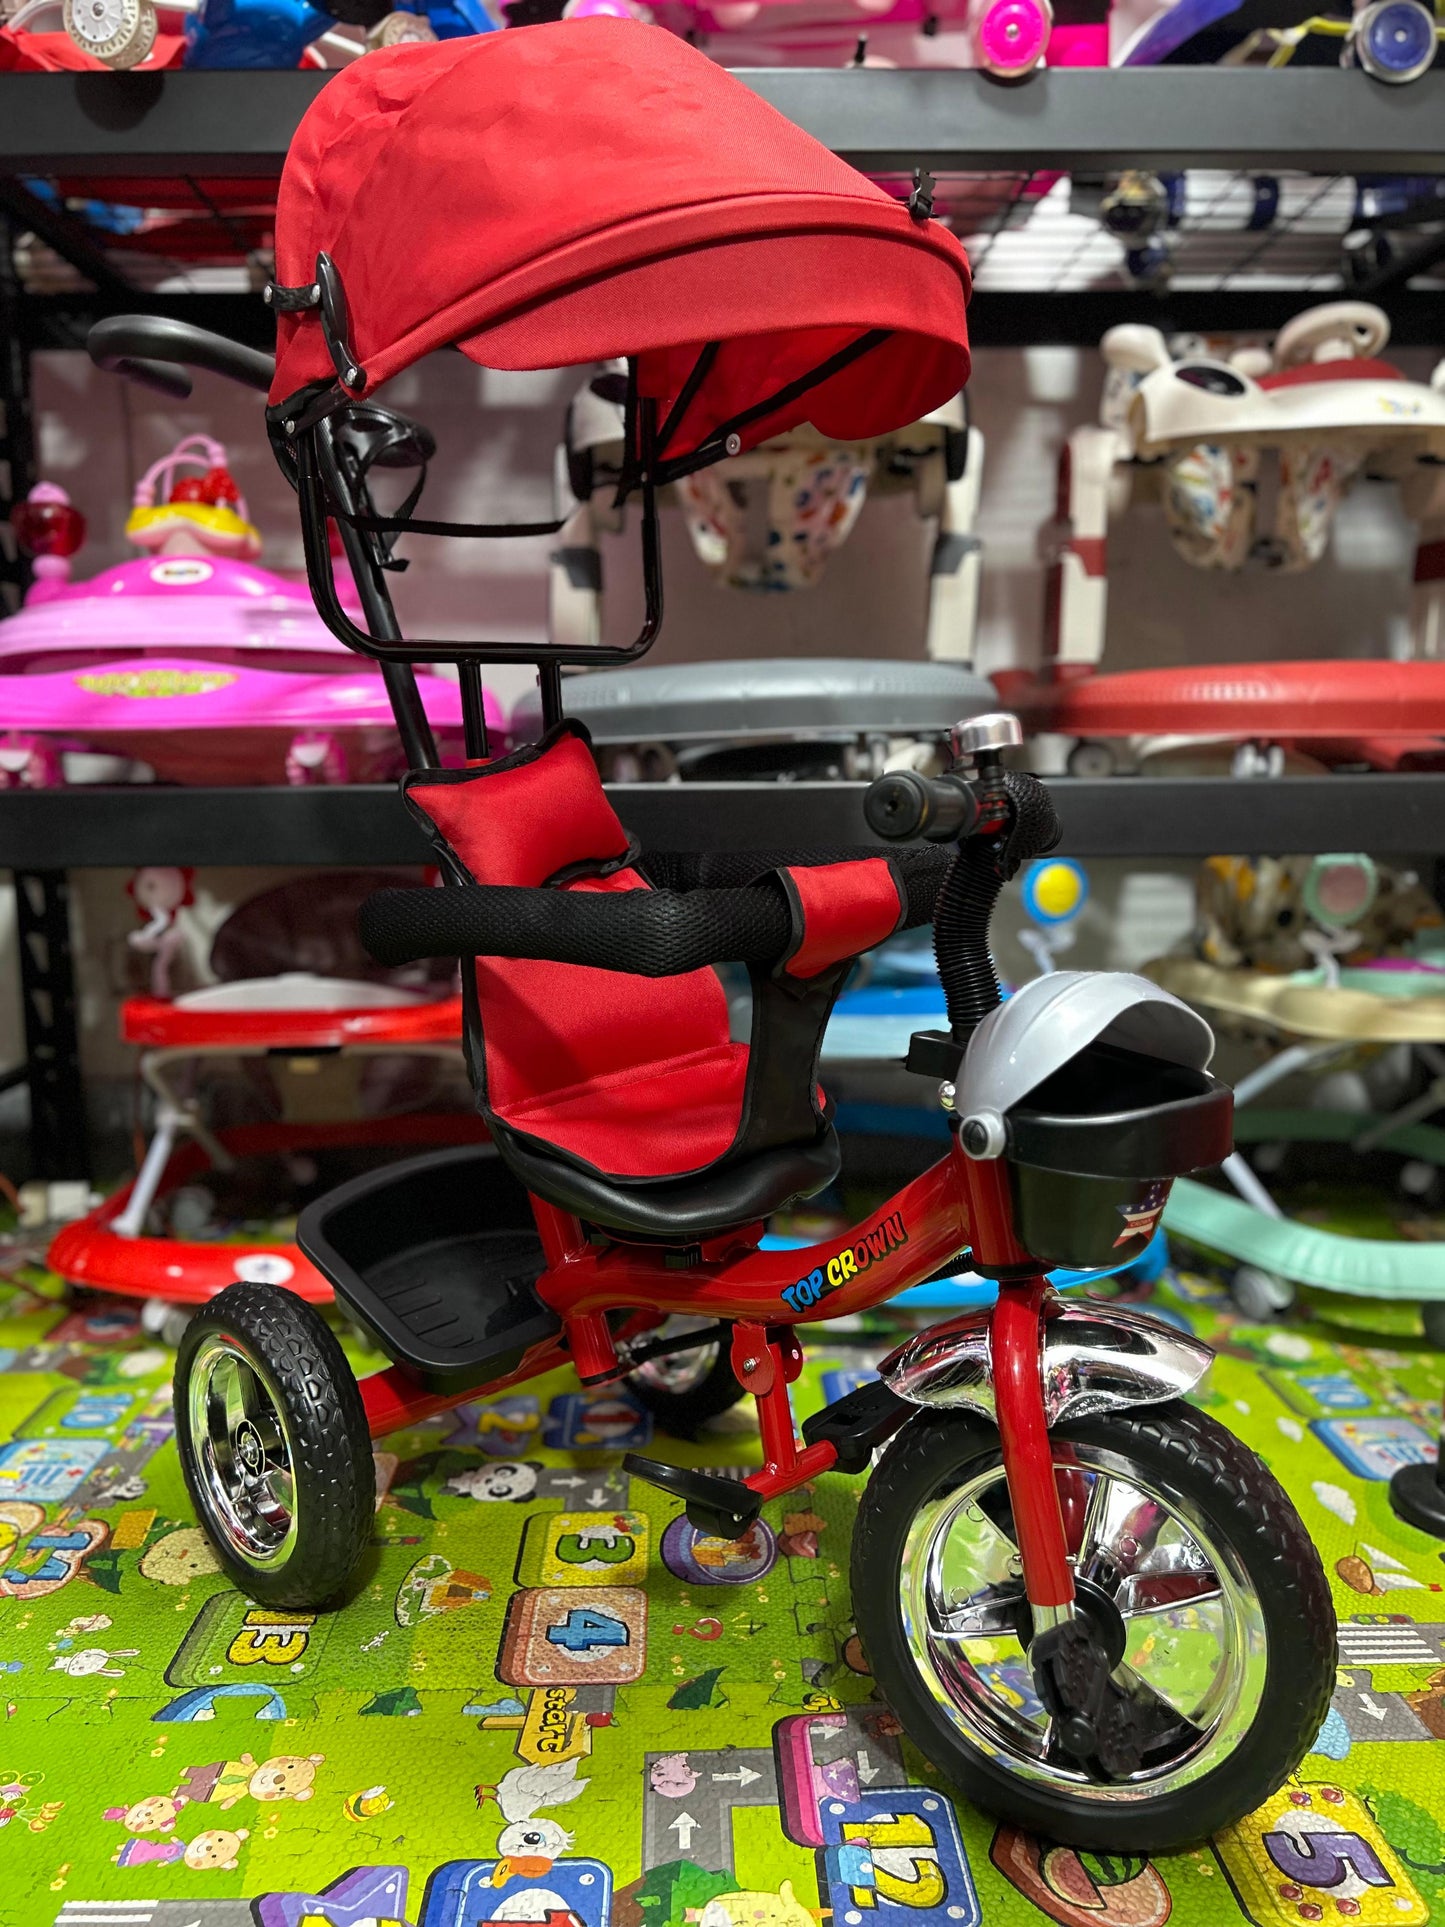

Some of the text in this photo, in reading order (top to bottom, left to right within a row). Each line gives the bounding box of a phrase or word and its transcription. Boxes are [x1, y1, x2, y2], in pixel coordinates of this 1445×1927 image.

[779, 1211, 908, 1313] TOP CROWN
[555, 1534, 636, 1564] 3
[225, 1609, 318, 1666] 13
[545, 1609, 630, 1651] 4
[536, 1687, 568, 1753] start
[838, 1812, 949, 1910] 12
[1261, 1830, 1396, 1888] 5
